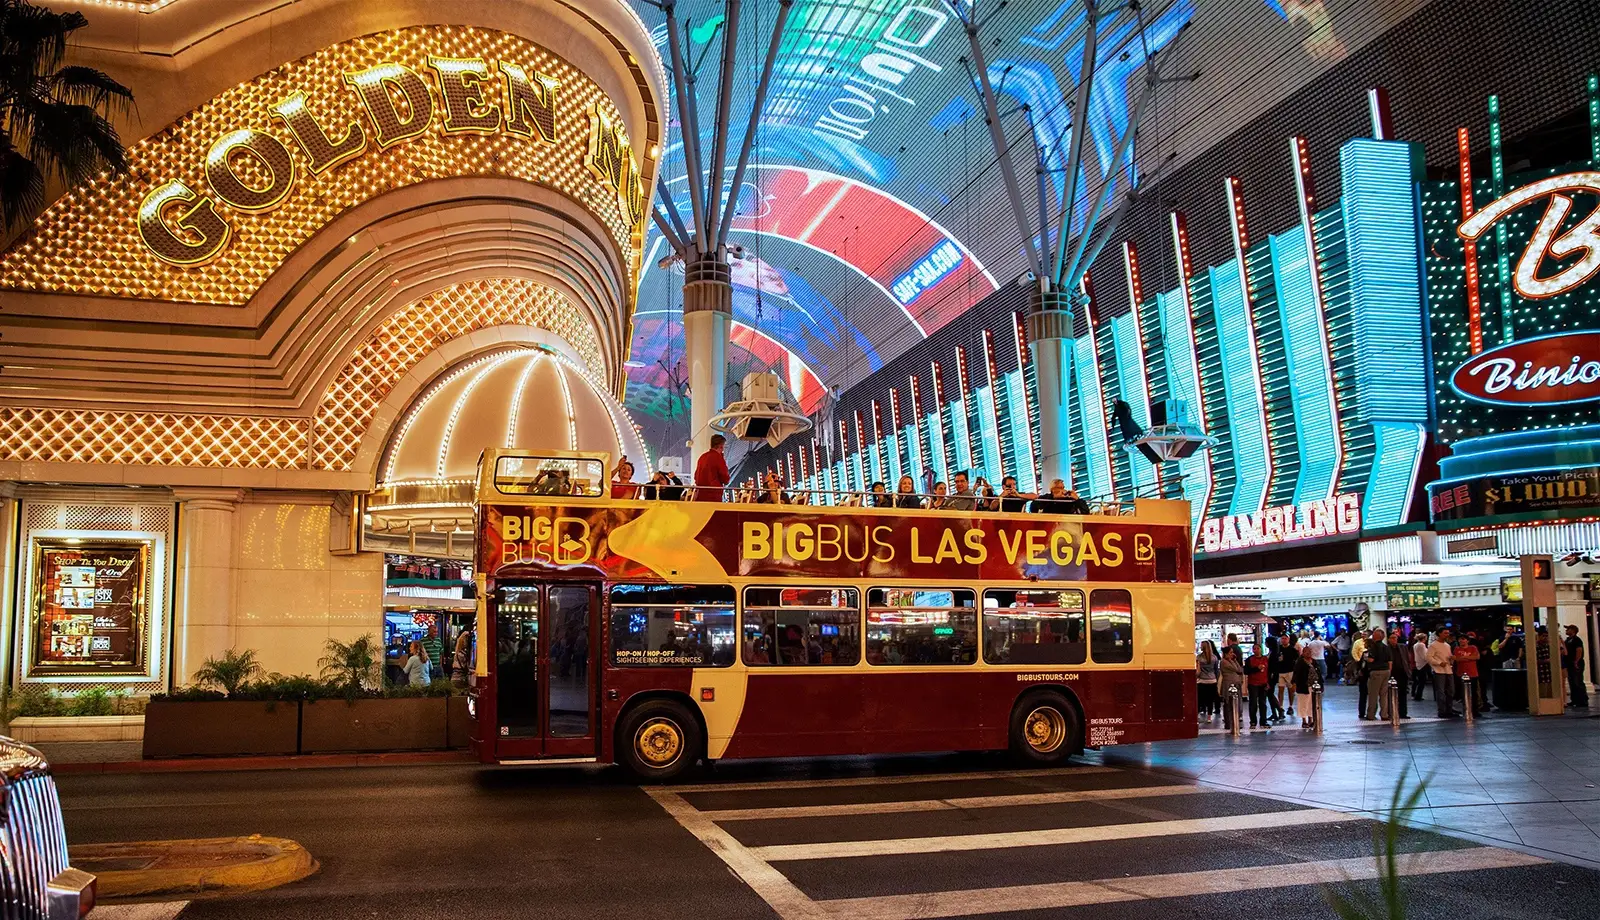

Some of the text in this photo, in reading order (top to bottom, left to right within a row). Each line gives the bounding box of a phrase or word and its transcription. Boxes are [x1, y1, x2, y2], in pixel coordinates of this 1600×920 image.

[815, 3, 949, 141] olution
[136, 53, 645, 268] GOLDEN NU
[1469, 354, 1600, 394] Binio
[1500, 478, 1529, 486] Take
[1431, 484, 1471, 515] REE
[502, 515, 551, 541] BIG
[1203, 493, 1361, 553] GAMBLING
[502, 542, 552, 565] BUS
[910, 526, 988, 566] LAS
[997, 528, 1124, 568] VEGAS
[659, 656, 702, 664] EXPERIENCES
[1016, 673, 1080, 681] BIGBUSTOURS.COM
